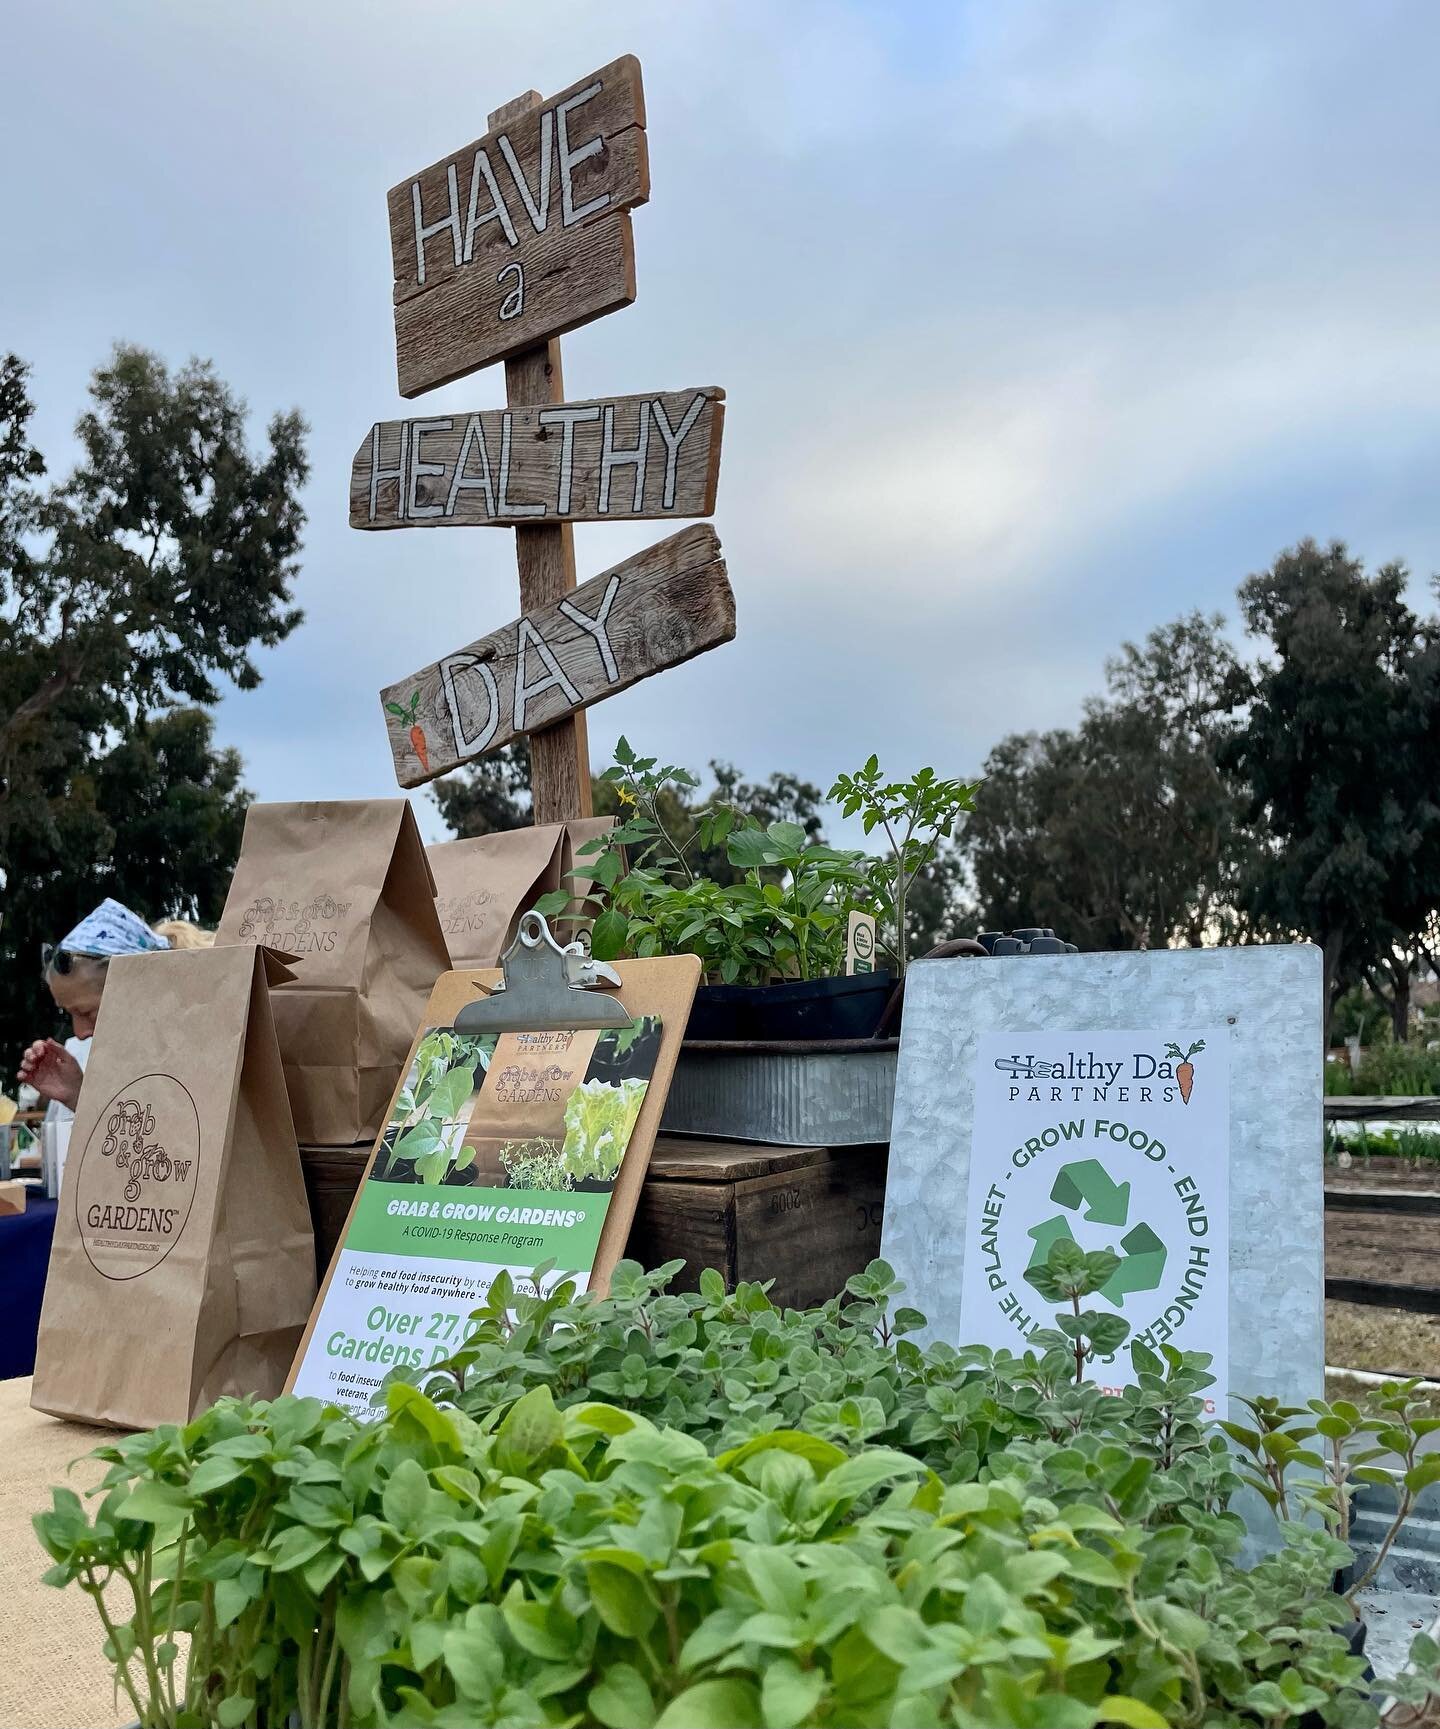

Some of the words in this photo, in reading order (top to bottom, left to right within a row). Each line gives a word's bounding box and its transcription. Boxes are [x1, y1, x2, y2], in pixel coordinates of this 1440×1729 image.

[411, 82, 612, 285] HAVE
[497, 262, 525, 320] a
[369, 393, 707, 521] HEALTHY
[439, 574, 621, 759] DAY
[497, 1088, 562, 1103] GARDENS
[116, 1140, 131, 1168] &
[1012, 1118, 1086, 1168] GROW
[1094, 1119, 1166, 1163] FOOD
[387, 1200, 429, 1217] GRAB
[429, 1201, 440, 1218] &
[442, 1203, 496, 1222] GROW
[1174, 1175, 1209, 1237] END
[402, 1225, 410, 1236] A
[411, 1226, 454, 1240] COVID-19
[454, 1229, 500, 1245] Response
[501, 1232, 544, 1249] Program
[981, 1183, 1007, 1292] PLANET
[345, 1278, 354, 1286] to
[354, 1279, 376, 1290] grow
[377, 1280, 410, 1295] healthy
[410, 1283, 430, 1294] food
[430, 1286, 476, 1300] anywhere
[349, 1265, 379, 1280] Helping
[380, 1269, 398, 1279] end
[398, 1270, 417, 1281] food
[418, 1271, 463, 1288] insecurity
[464, 1276, 475, 1289] by
[1135, 1246, 1210, 1350] HUNGER
[367, 1305, 423, 1335] Over
[326, 1331, 425, 1369] Gardens
[328, 1371, 337, 1381] to
[337, 1370, 356, 1384] food
[336, 1386, 369, 1401] veterans,
